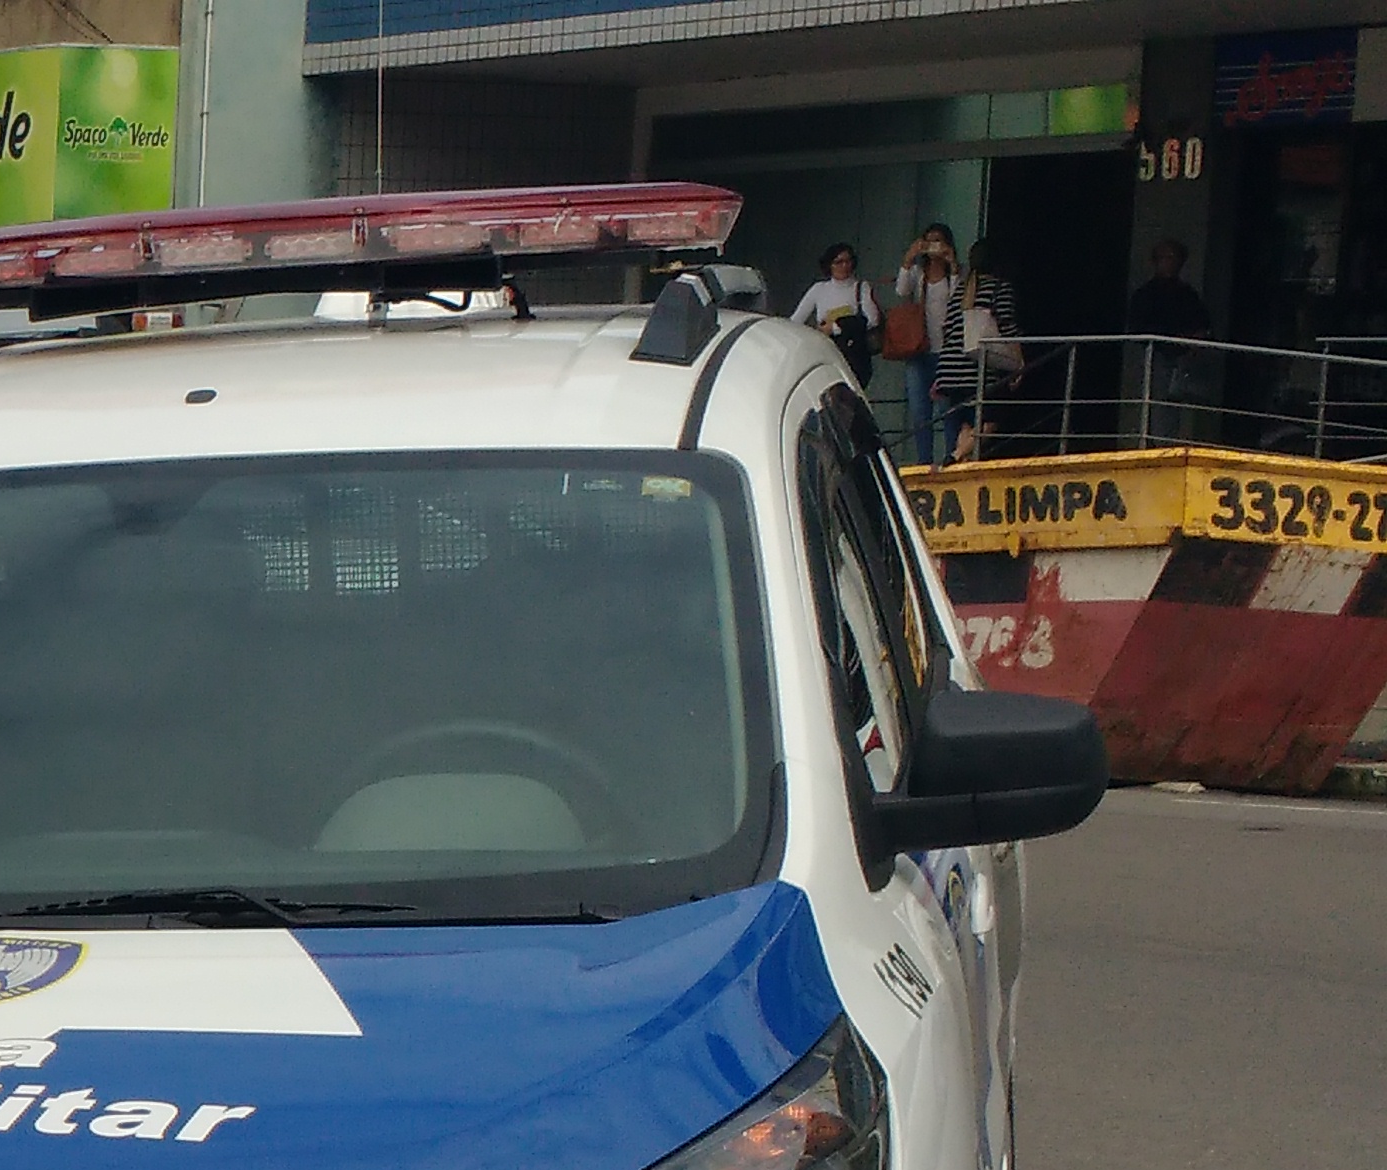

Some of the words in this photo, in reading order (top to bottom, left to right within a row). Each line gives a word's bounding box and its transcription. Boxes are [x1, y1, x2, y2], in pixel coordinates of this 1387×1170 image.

[129, 122, 168, 147] Verde
[1139, 137, 1203, 181] 560
[977, 479, 1127, 526] LIMPA
